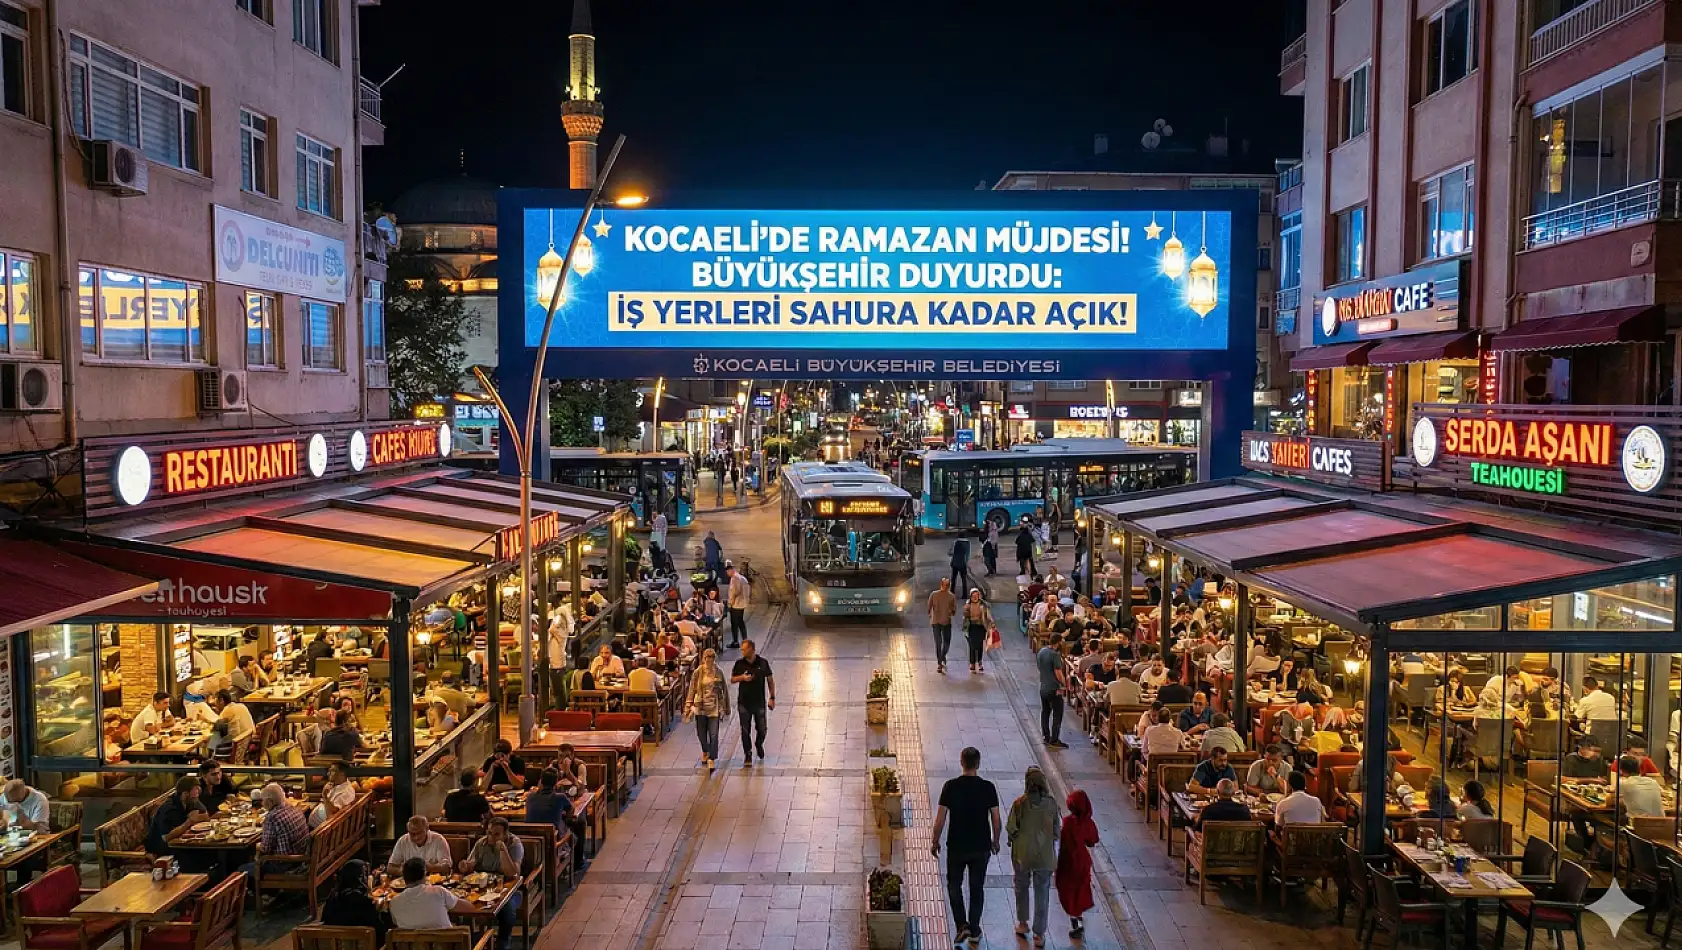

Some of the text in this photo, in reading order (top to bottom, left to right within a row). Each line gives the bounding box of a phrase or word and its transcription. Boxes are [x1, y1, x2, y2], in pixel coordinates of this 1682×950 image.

[624, 219, 1130, 253] KOCAELİ’DE RAMAZAN MÜJDESİ!
[692, 256, 1062, 293] BÜYÜKŞEHİR DUYURDU:
[617, 294, 1128, 330] İŞ YERLERİ SAHURA KADAR AÇIK!
[1394, 282, 1428, 312] CAFE
[713, 358, 1061, 374] KOCAELİ BÜYÜKŞEHİR BELEDİYESİ
[1445, 419, 1611, 467] SERDA AŞANI
[1470, 462, 1563, 494] TEAHOUESİ
